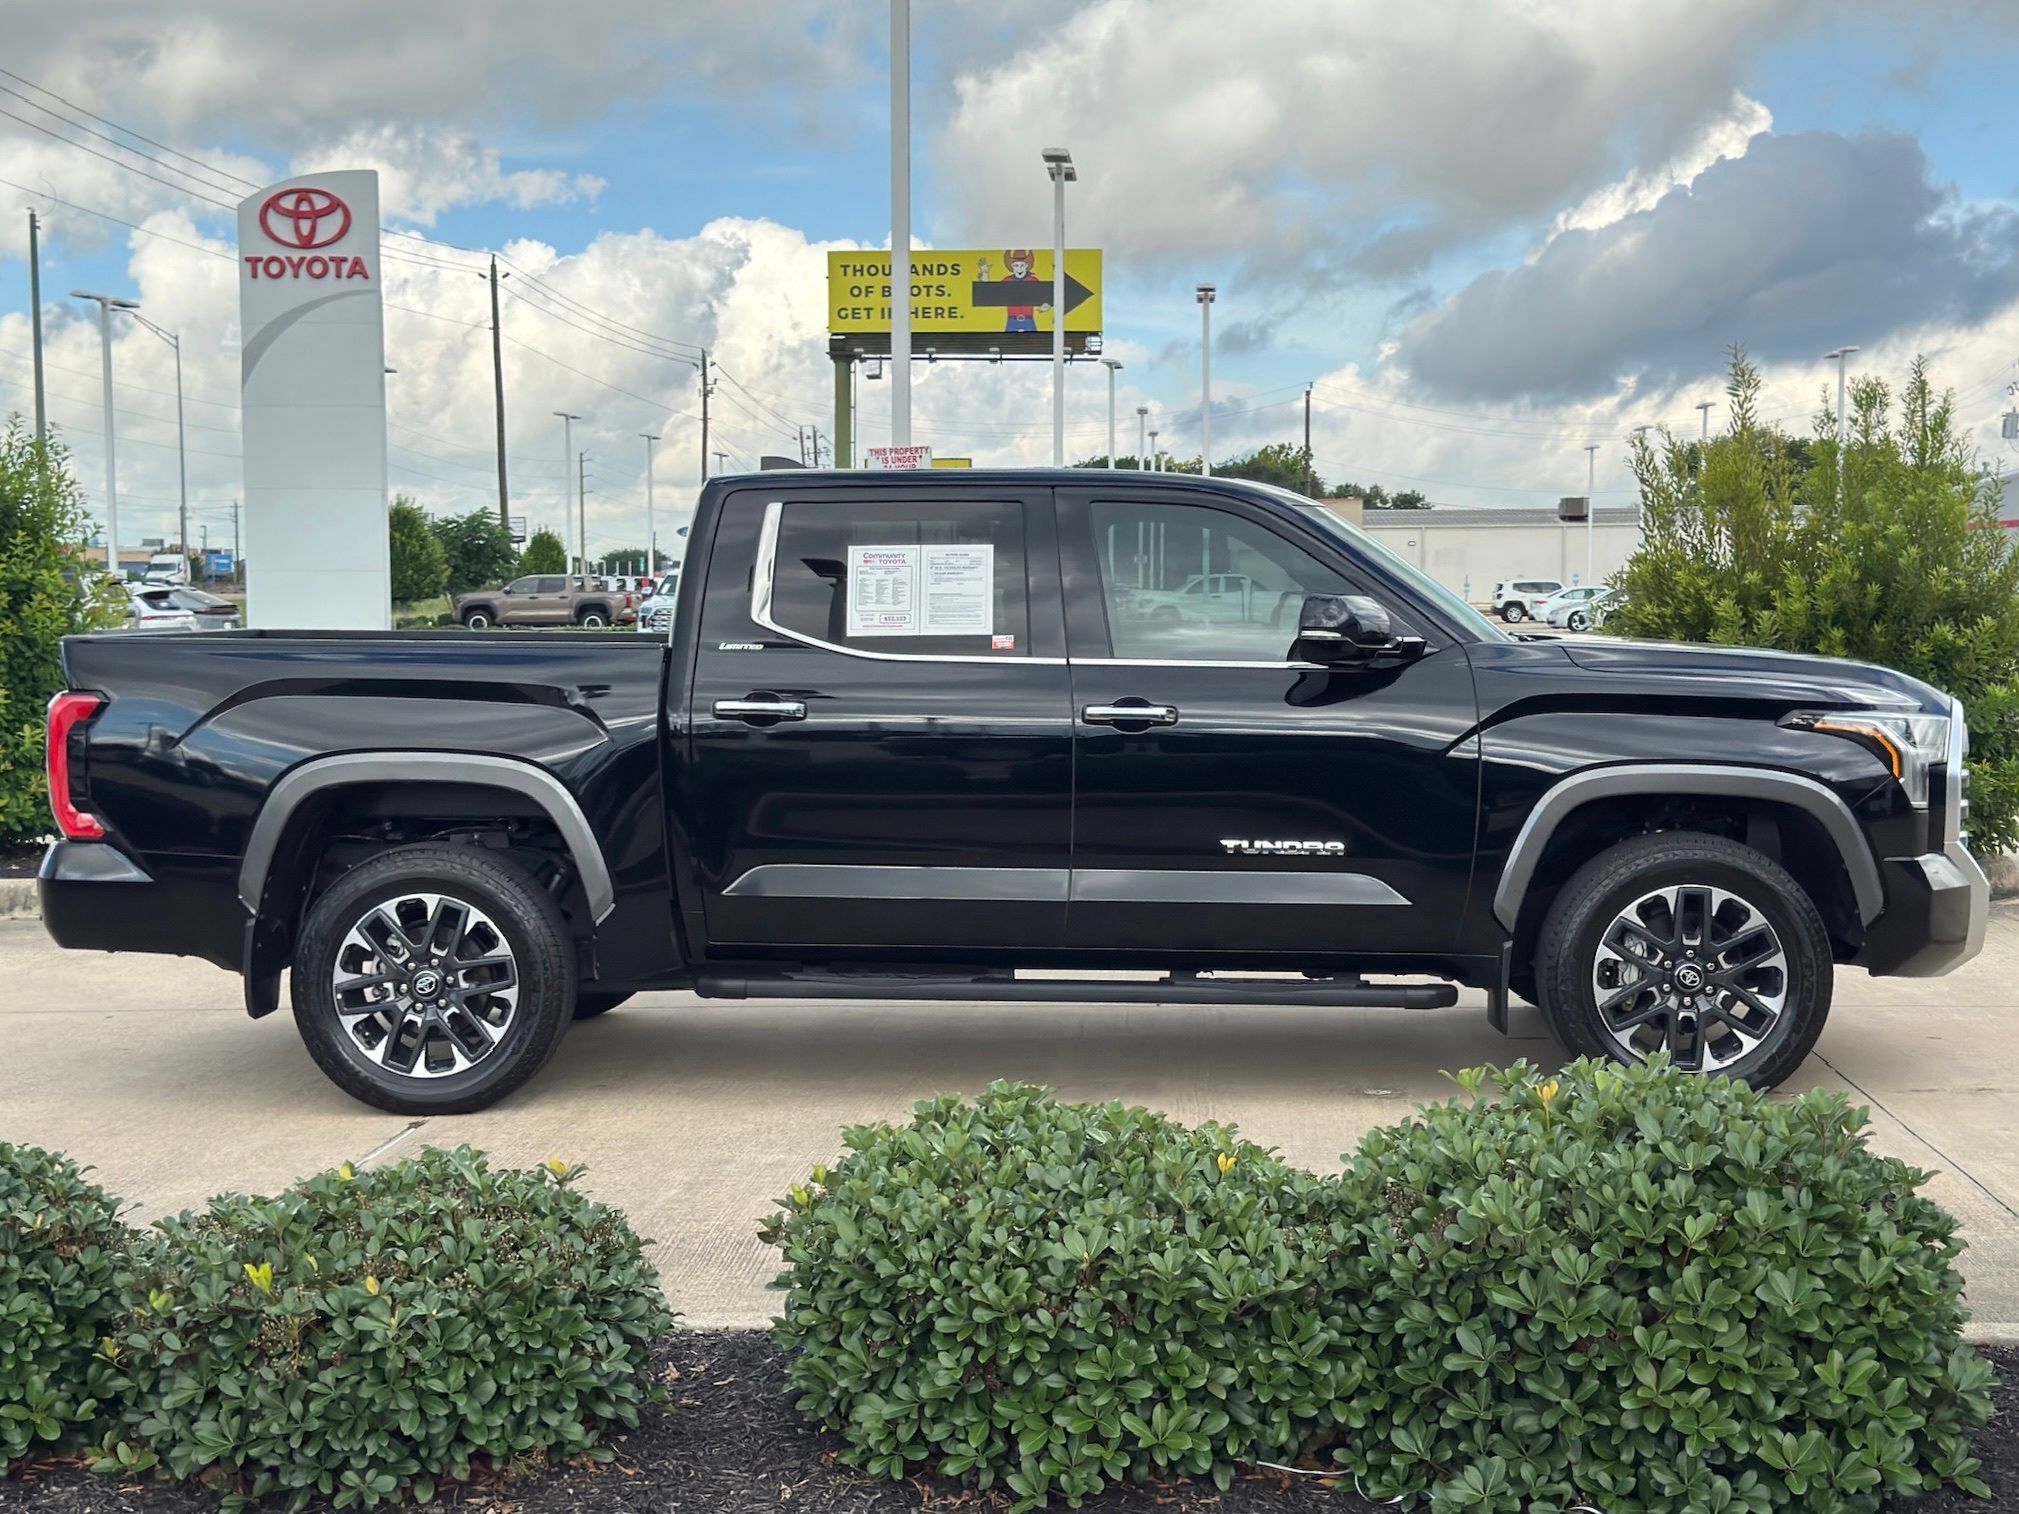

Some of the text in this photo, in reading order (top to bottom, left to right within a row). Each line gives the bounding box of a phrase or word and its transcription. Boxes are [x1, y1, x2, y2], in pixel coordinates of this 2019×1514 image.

[244, 255, 369, 279] TOYOTA
[840, 263, 961, 277] THOUANDS
[849, 284, 952, 298] OF BOTS.
[837, 307, 874, 320] GET
[869, 447, 929, 457] THIS PROPERTY
[881, 456, 917, 464] IS UNDER
[1219, 839, 1345, 856] TUNDRA
